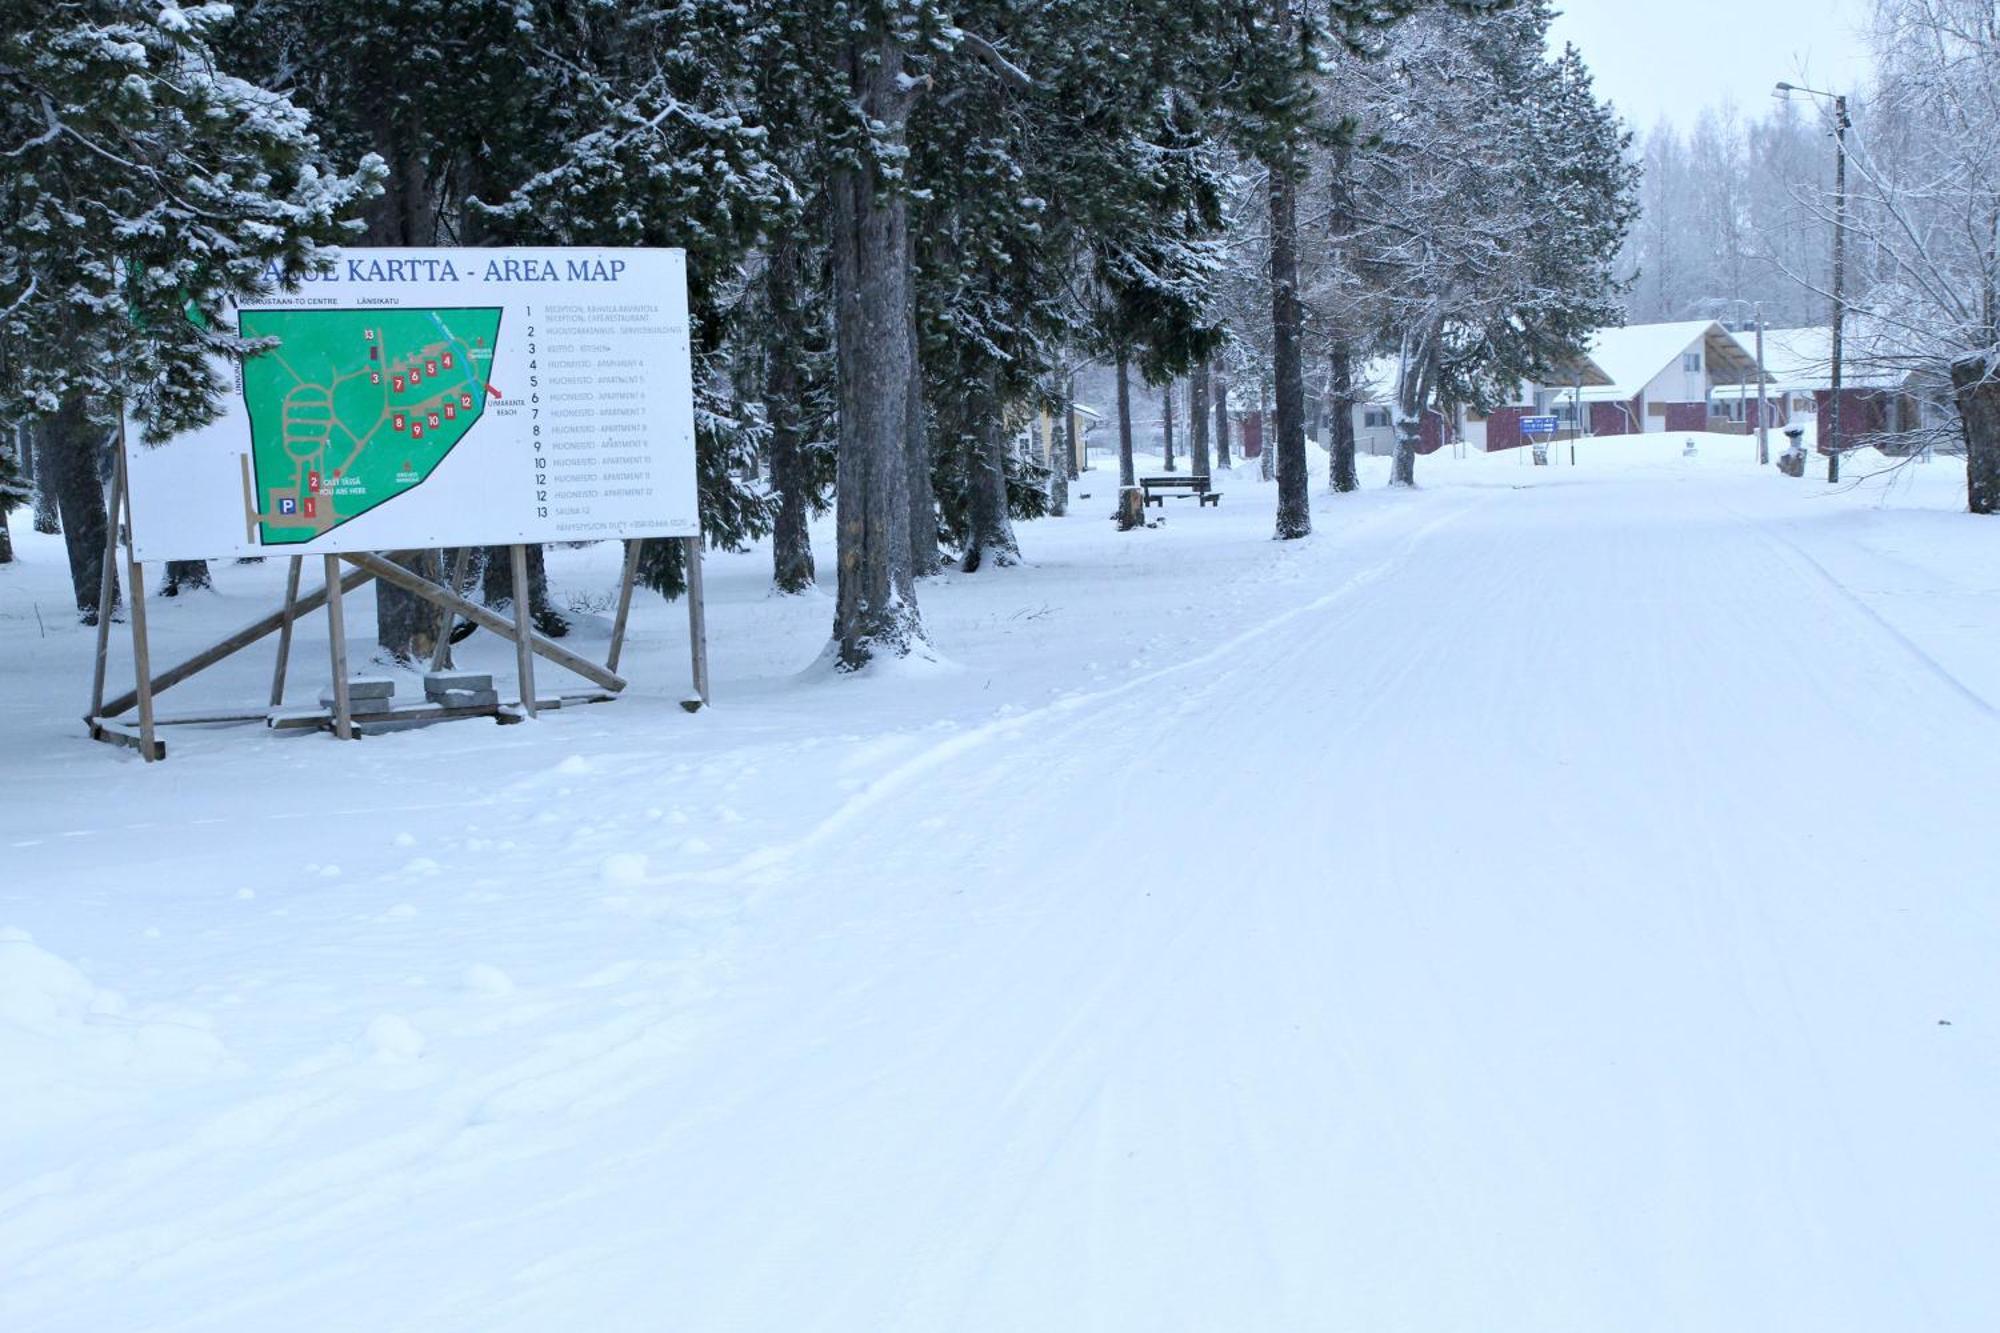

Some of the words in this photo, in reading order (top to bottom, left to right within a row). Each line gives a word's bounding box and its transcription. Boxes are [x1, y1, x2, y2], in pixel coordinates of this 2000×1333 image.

[349, 259, 459, 282] KARTTA
[483, 259, 560, 282] AREA
[567, 259, 625, 282] MAP
[307, 297, 338, 305] CENTRE
[526, 306, 531, 317] 1
[364, 329, 375, 341] 13
[527, 326, 535, 337] 2
[528, 343, 536, 354] 3
[443, 355, 451, 365] 4
[529, 359, 537, 370] 4
[427, 365, 435, 375] 5
[371, 373, 379, 384] 3
[411, 372, 419, 381] 6
[530, 375, 538, 387] 5
[394, 379, 402, 390] 7
[462, 396, 471, 407] 12
[531, 392, 539, 404] 6
[447, 407, 454, 417] 11
[532, 408, 539, 420] 7
[395, 418, 403, 428] 8
[428, 416, 439, 426] 10
[413, 425, 421, 435] 9
[533, 424, 540, 437] 8
[534, 441, 541, 452] 9
[535, 457, 546, 468] 10
[311, 476, 318, 487] 2
[535, 473, 547, 485] 12
[319, 487, 333, 496] YOU
[536, 490, 548, 501] 12
[283, 499, 294, 513] P
[307, 502, 312, 513] 1
[537, 506, 548, 518] 13
